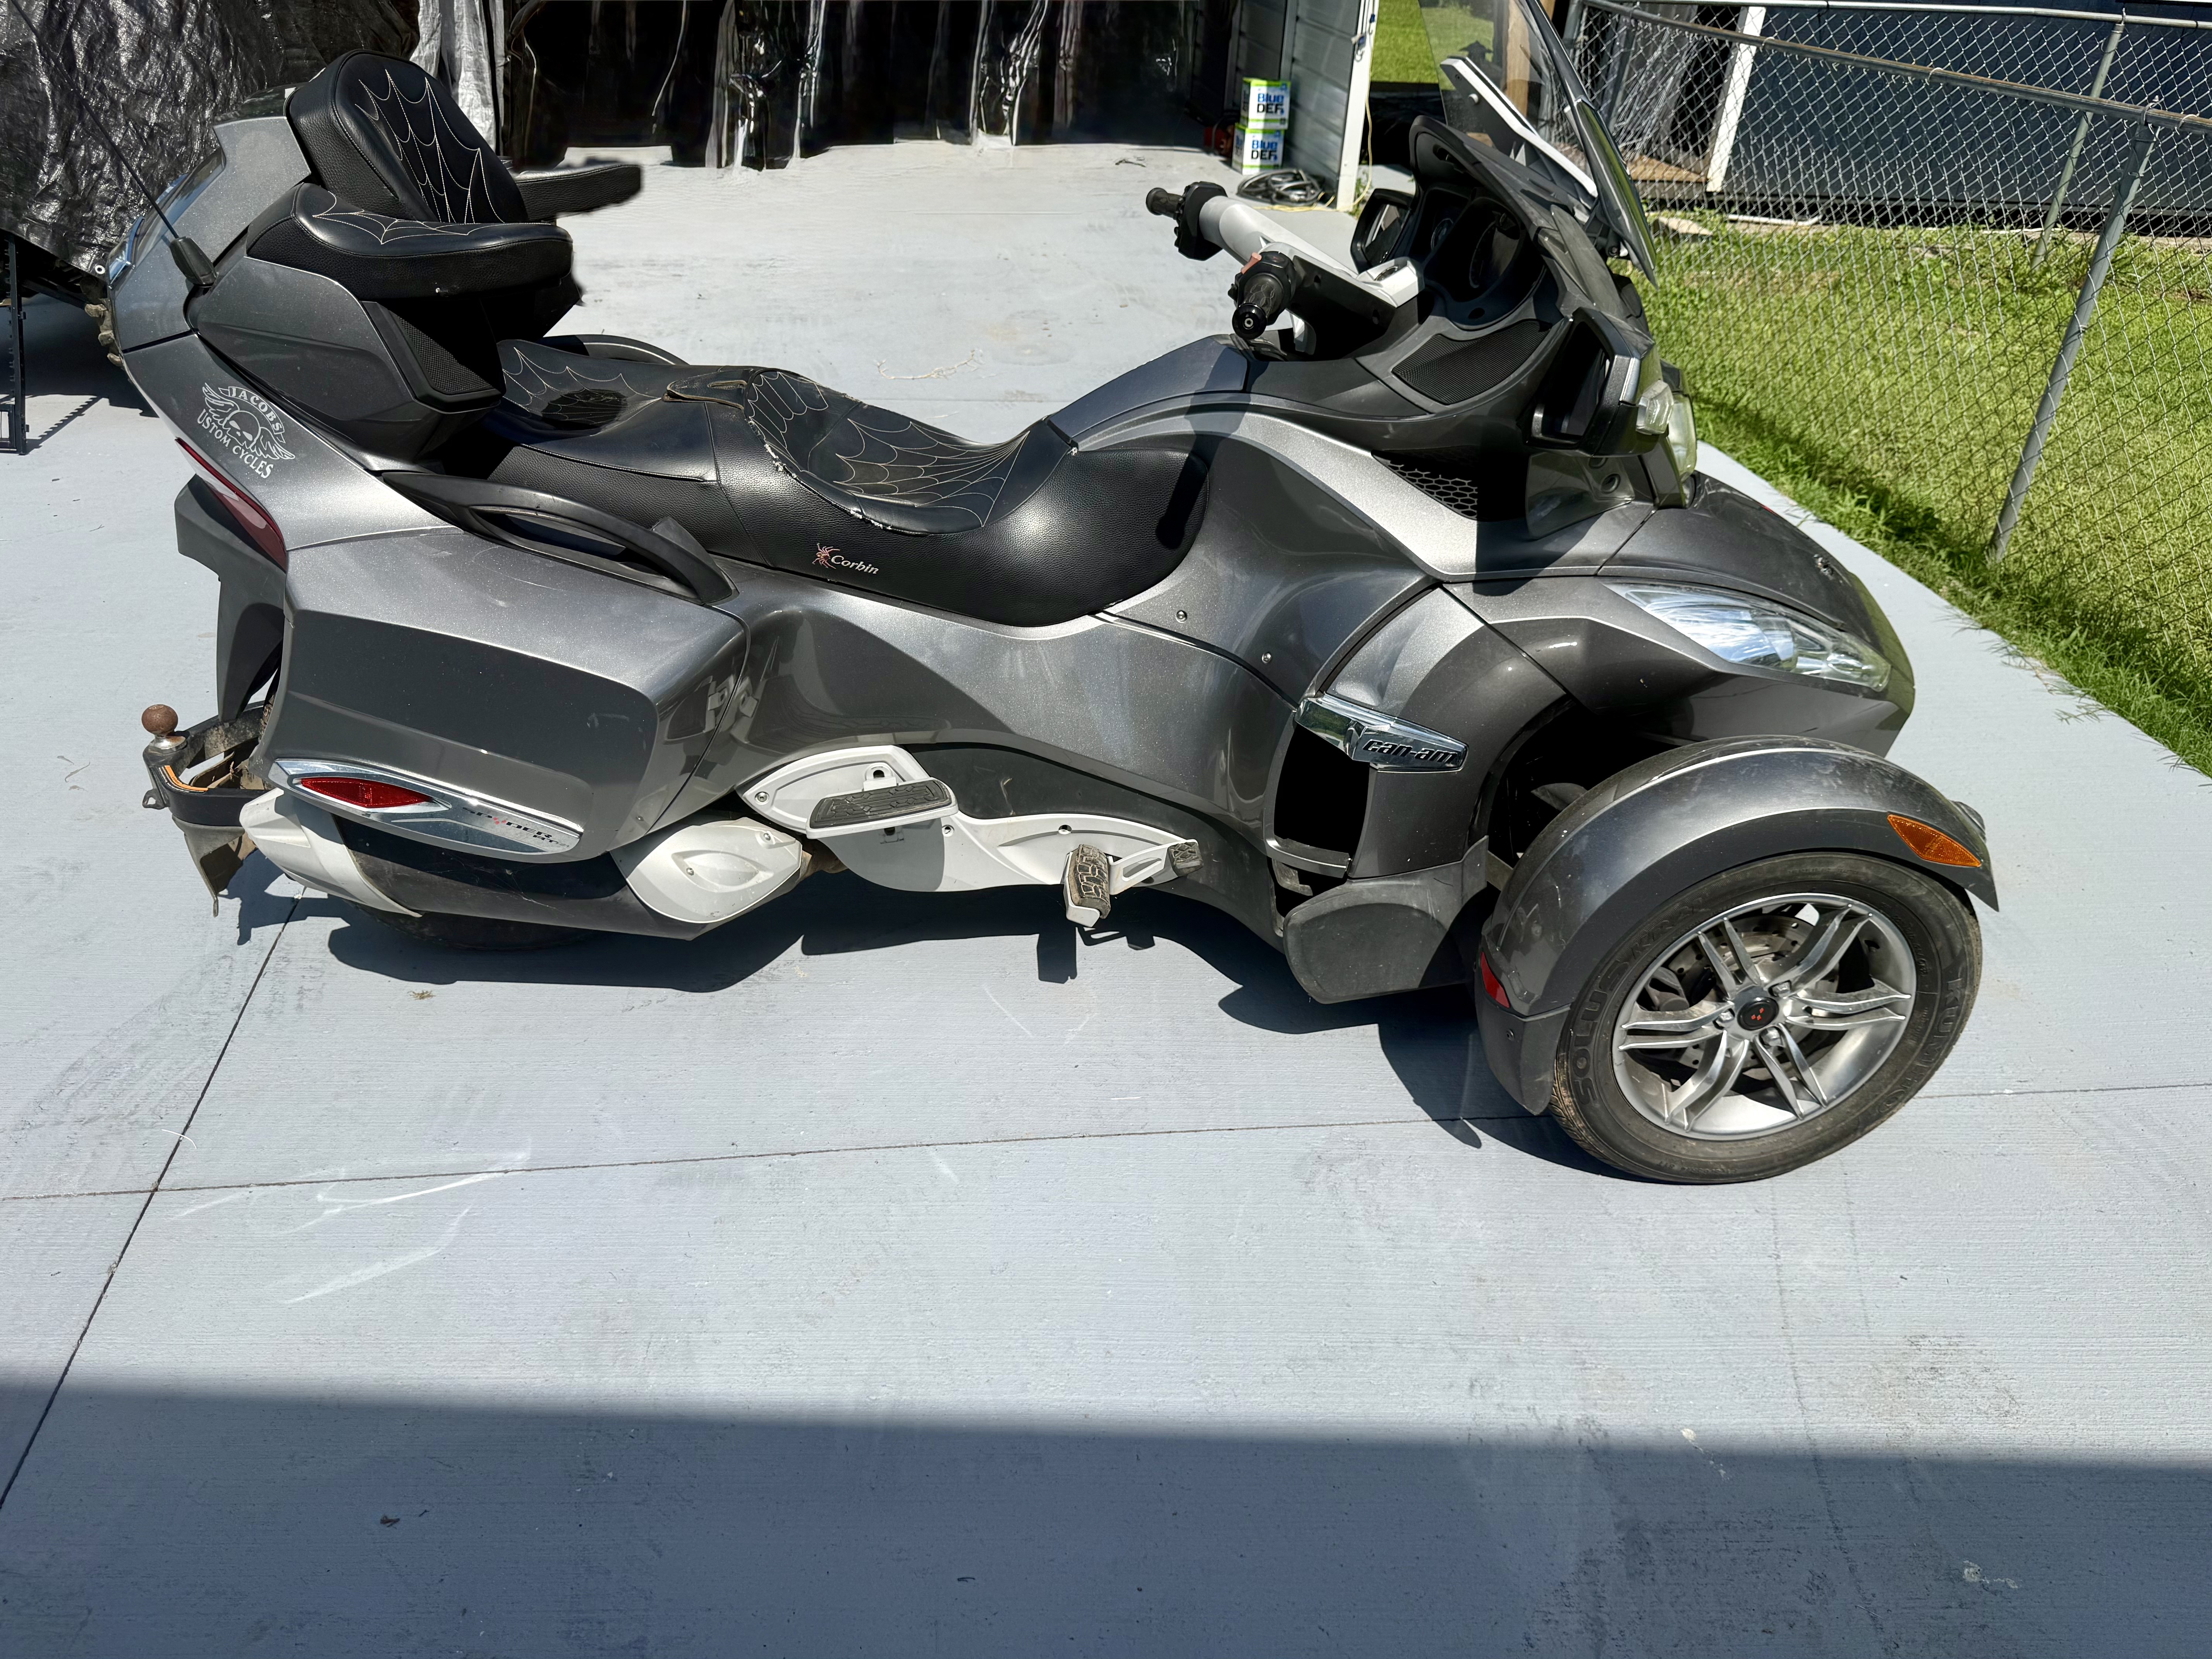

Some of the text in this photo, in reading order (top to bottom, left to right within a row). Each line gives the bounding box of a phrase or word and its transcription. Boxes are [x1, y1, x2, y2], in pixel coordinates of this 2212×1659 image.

[1258, 93, 1284, 103] Blue
[1257, 103, 1283, 113] DEF
[1252, 140, 1278, 149] Blue
[1251, 150, 1277, 159] DEF
[232, 388, 282, 431] JACOBS
[232, 445, 273, 478] CYCLES
[831, 555, 879, 574] Corbin
[1363, 739, 1457, 763] can-am
[1571, 958, 1631, 1106] SOLUS
